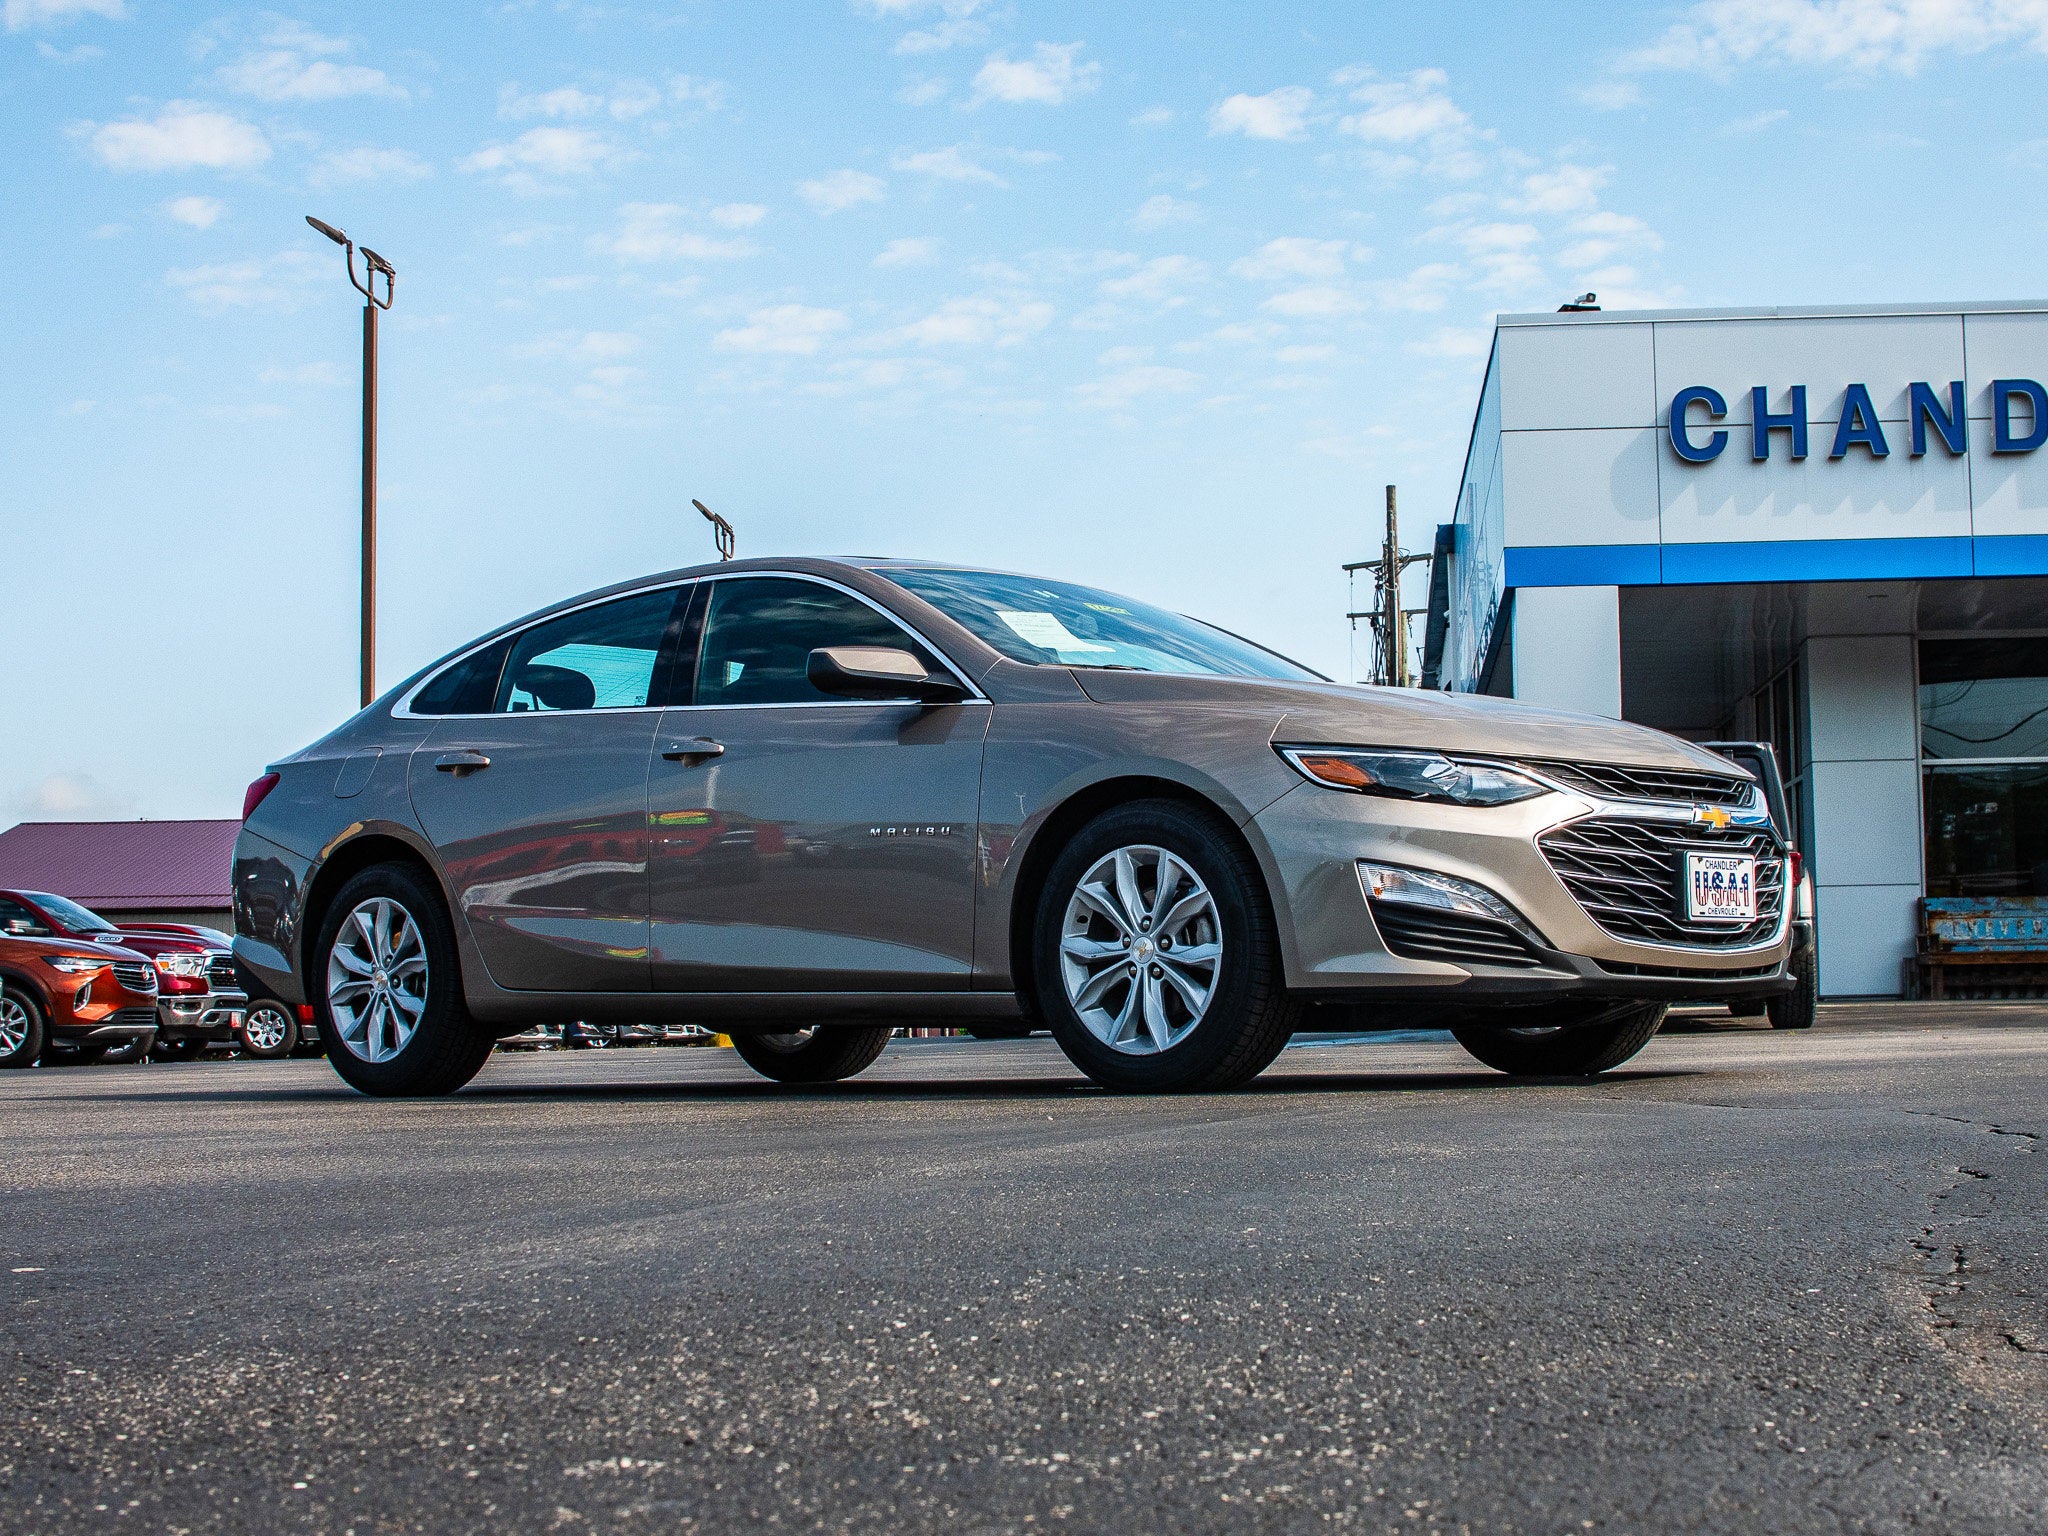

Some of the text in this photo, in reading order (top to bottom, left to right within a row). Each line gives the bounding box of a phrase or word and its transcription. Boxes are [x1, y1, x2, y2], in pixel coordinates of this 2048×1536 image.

[1669, 379, 2048, 462] CHAND
[870, 826, 950, 837] MALIBU
[1705, 860, 1737, 870] CHANDLER
[1708, 907, 1738, 915] CHEVROLET
